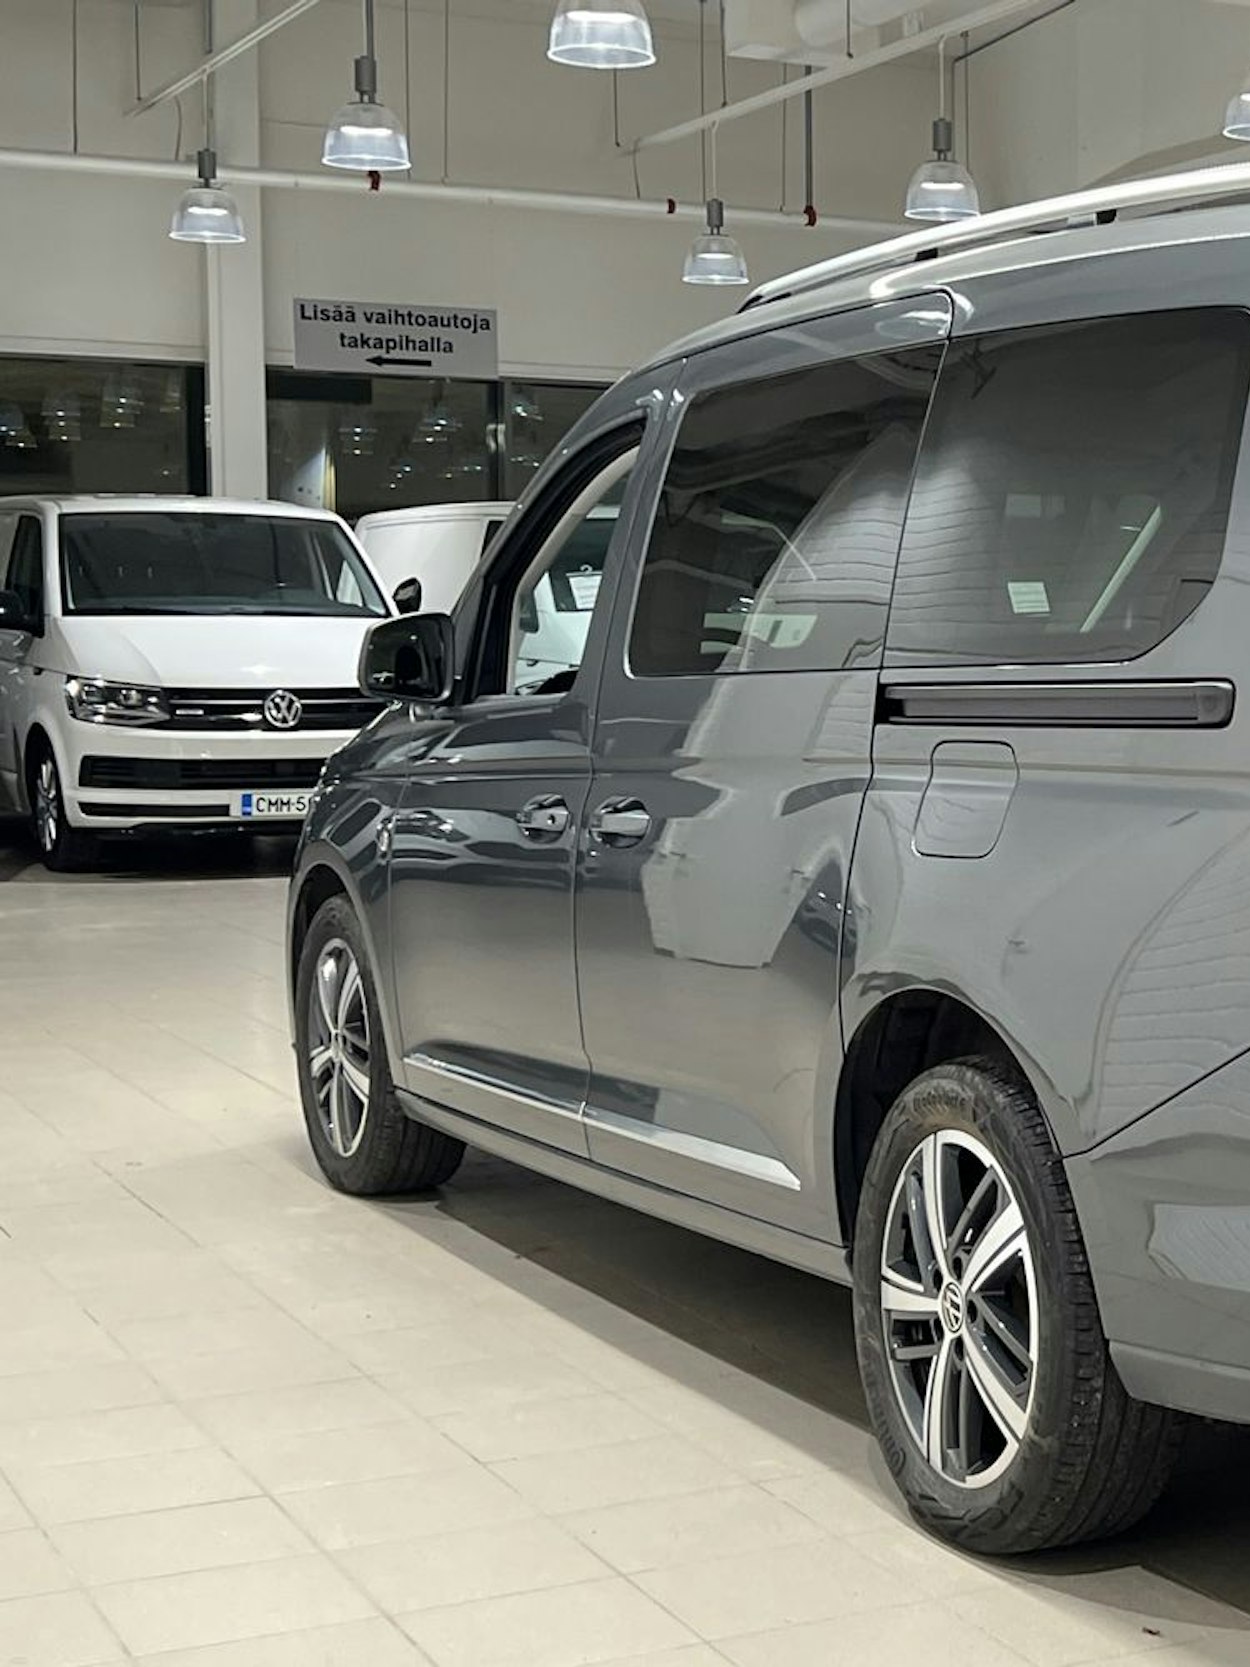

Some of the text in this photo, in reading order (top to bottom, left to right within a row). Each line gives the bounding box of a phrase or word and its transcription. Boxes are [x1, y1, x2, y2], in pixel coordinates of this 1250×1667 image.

[300, 304, 491, 333] Lisää vaihtoautoja
[339, 332, 454, 354] takapihalla
[256, 796, 312, 813] CMM-5
